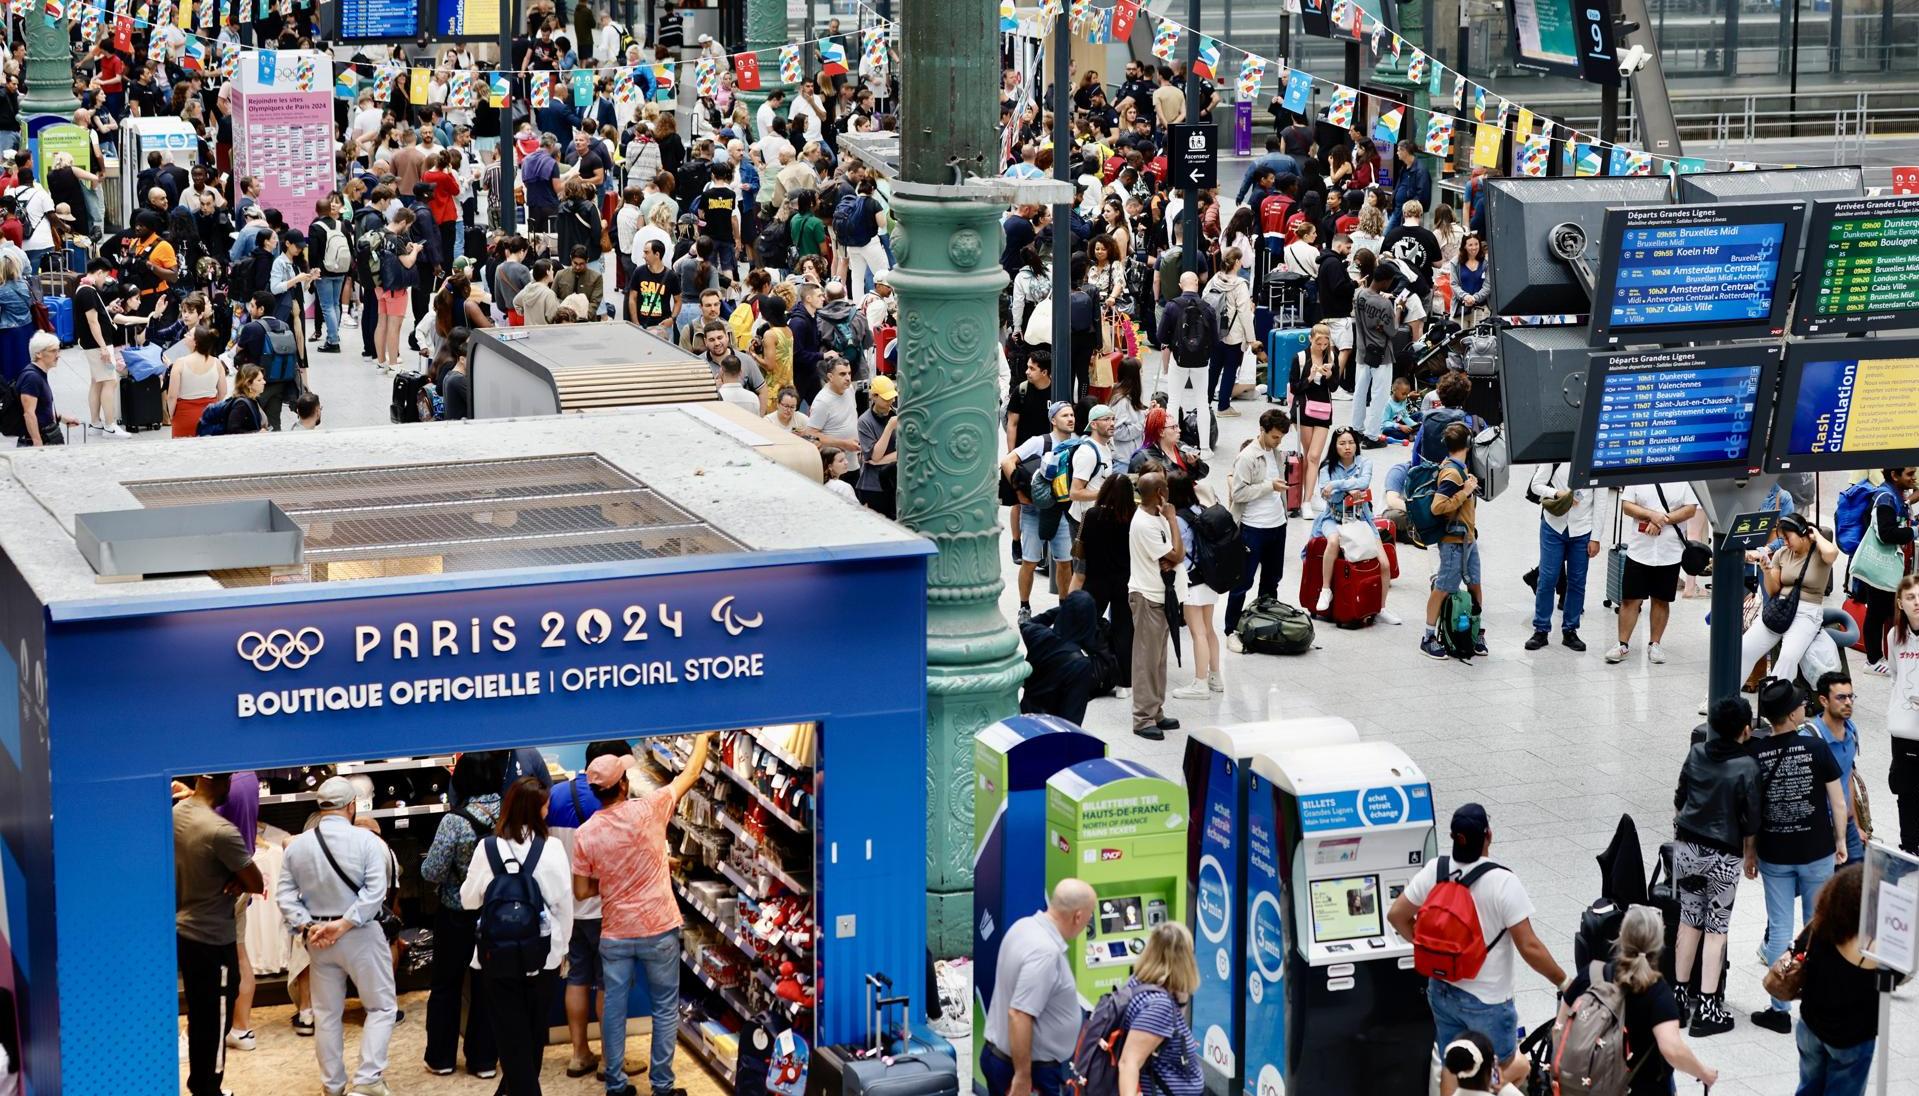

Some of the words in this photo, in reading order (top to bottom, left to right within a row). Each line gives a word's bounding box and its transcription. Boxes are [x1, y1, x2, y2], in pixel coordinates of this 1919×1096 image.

[1591, 23, 1603, 53] 9
[248, 105, 284, 113] Olympiques
[1835, 203, 1865, 211] Arrivées
[1866, 201, 1896, 209] Grandes
[1628, 211, 1657, 220] Départs
[1660, 210, 1690, 218] Grandes
[1692, 209, 1716, 218] Lignes
[1680, 228, 1718, 238] Bruxelles
[1720, 226, 1738, 236] Midi
[1843, 231, 1879, 239] Dunkerque
[1637, 240, 1668, 248] Bruxelles
[1670, 239, 1685, 247] Midi
[1880, 238, 1918, 247] Boulogne
[1677, 248, 1701, 257] Koeln
[1703, 245, 1719, 255] Hbf
[1877, 256, 1906, 264] Bruxelles
[1651, 269, 1671, 277] 10h24
[1673, 266, 1722, 275] Amsterdam
[1724, 263, 1760, 273] Centraal
[1875, 265, 1904, 273] Bruxelles
[1686, 275, 1717, 283] Bruxelles
[1719, 274, 1733, 282] Midi
[1648, 287, 1667, 295] 10h24
[1670, 285, 1719, 294] Amsterdam
[1721, 282, 1756, 292] Centraal
[1647, 295, 1684, 304] Antwerpen
[1685, 294, 1713, 302] Centraal
[1646, 306, 1665, 314] 10h27
[1667, 304, 1693, 313] Calais
[1695, 302, 1713, 312] Ville
[1868, 301, 1905, 309] Amsterdam
[1630, 315, 1645, 323] Ville
[1609, 356, 1638, 366] Départs
[1640, 355, 1670, 363] Grandes
[1672, 353, 1695, 362] Lignes
[1659, 372, 1696, 381] Dunkerque
[1658, 381, 1701, 390] Valenciennes
[1656, 390, 1685, 399] Beauvais
[1655, 396, 1733, 408] Saint-Just-en-Chaussée
[1653, 408, 1704, 418] Enregistrement
[1705, 406, 1727, 414] ouvert
[1828, 365, 1856, 452] circulation
[1651, 418, 1677, 427] Amiens
[1724, 380, 1750, 459] départs
[1650, 428, 1667, 436] Laon
[1811, 413, 1831, 453] flash
[1649, 436, 1679, 445] Bruxelles
[1647, 446, 1666, 454] Koeln
[1668, 444, 1681, 452] Hbf
[1624, 457, 1642, 465] 12h01
[1646, 455, 1675, 464] Beauvais
[1758, 520, 1768, 529] P
[540, 603, 683, 648] 2024
[237, 683, 383, 718] BOUTIQUE
[389, 671, 540, 705] OFFICIELLE
[561, 660, 678, 691] OFFICIAL
[684, 653, 764, 682] STORE
[1082, 797, 1138, 811] BILLETTERIE
[1303, 799, 1336, 809] BILLETS
[1082, 803, 1170, 820] HAUTS-DE-FRANCE
[1214, 802, 1230, 819] achat
[1304, 808, 1331, 817] Grandes
[1332, 806, 1354, 816] Lignes
[1370, 809, 1398, 819] échange
[1082, 821, 1107, 830] NORTH
[1109, 820, 1119, 828] OF
[1120, 817, 1148, 826] FRANCE
[1212, 815, 1231, 834] retrait
[1305, 818, 1319, 826] Main
[1330, 816, 1346, 824] trains
[1207, 825, 1230, 850] échange
[1251, 825, 1268, 842] achat
[1251, 839, 1271, 859] retrait
[1102, 851, 1122, 860] SNCF
[1251, 852, 1276, 878] échange
[1201, 888, 1208, 910] 3
[1208, 902, 1223, 921] min
[1257, 925, 1264, 948] 3
[1264, 940, 1280, 959] min
